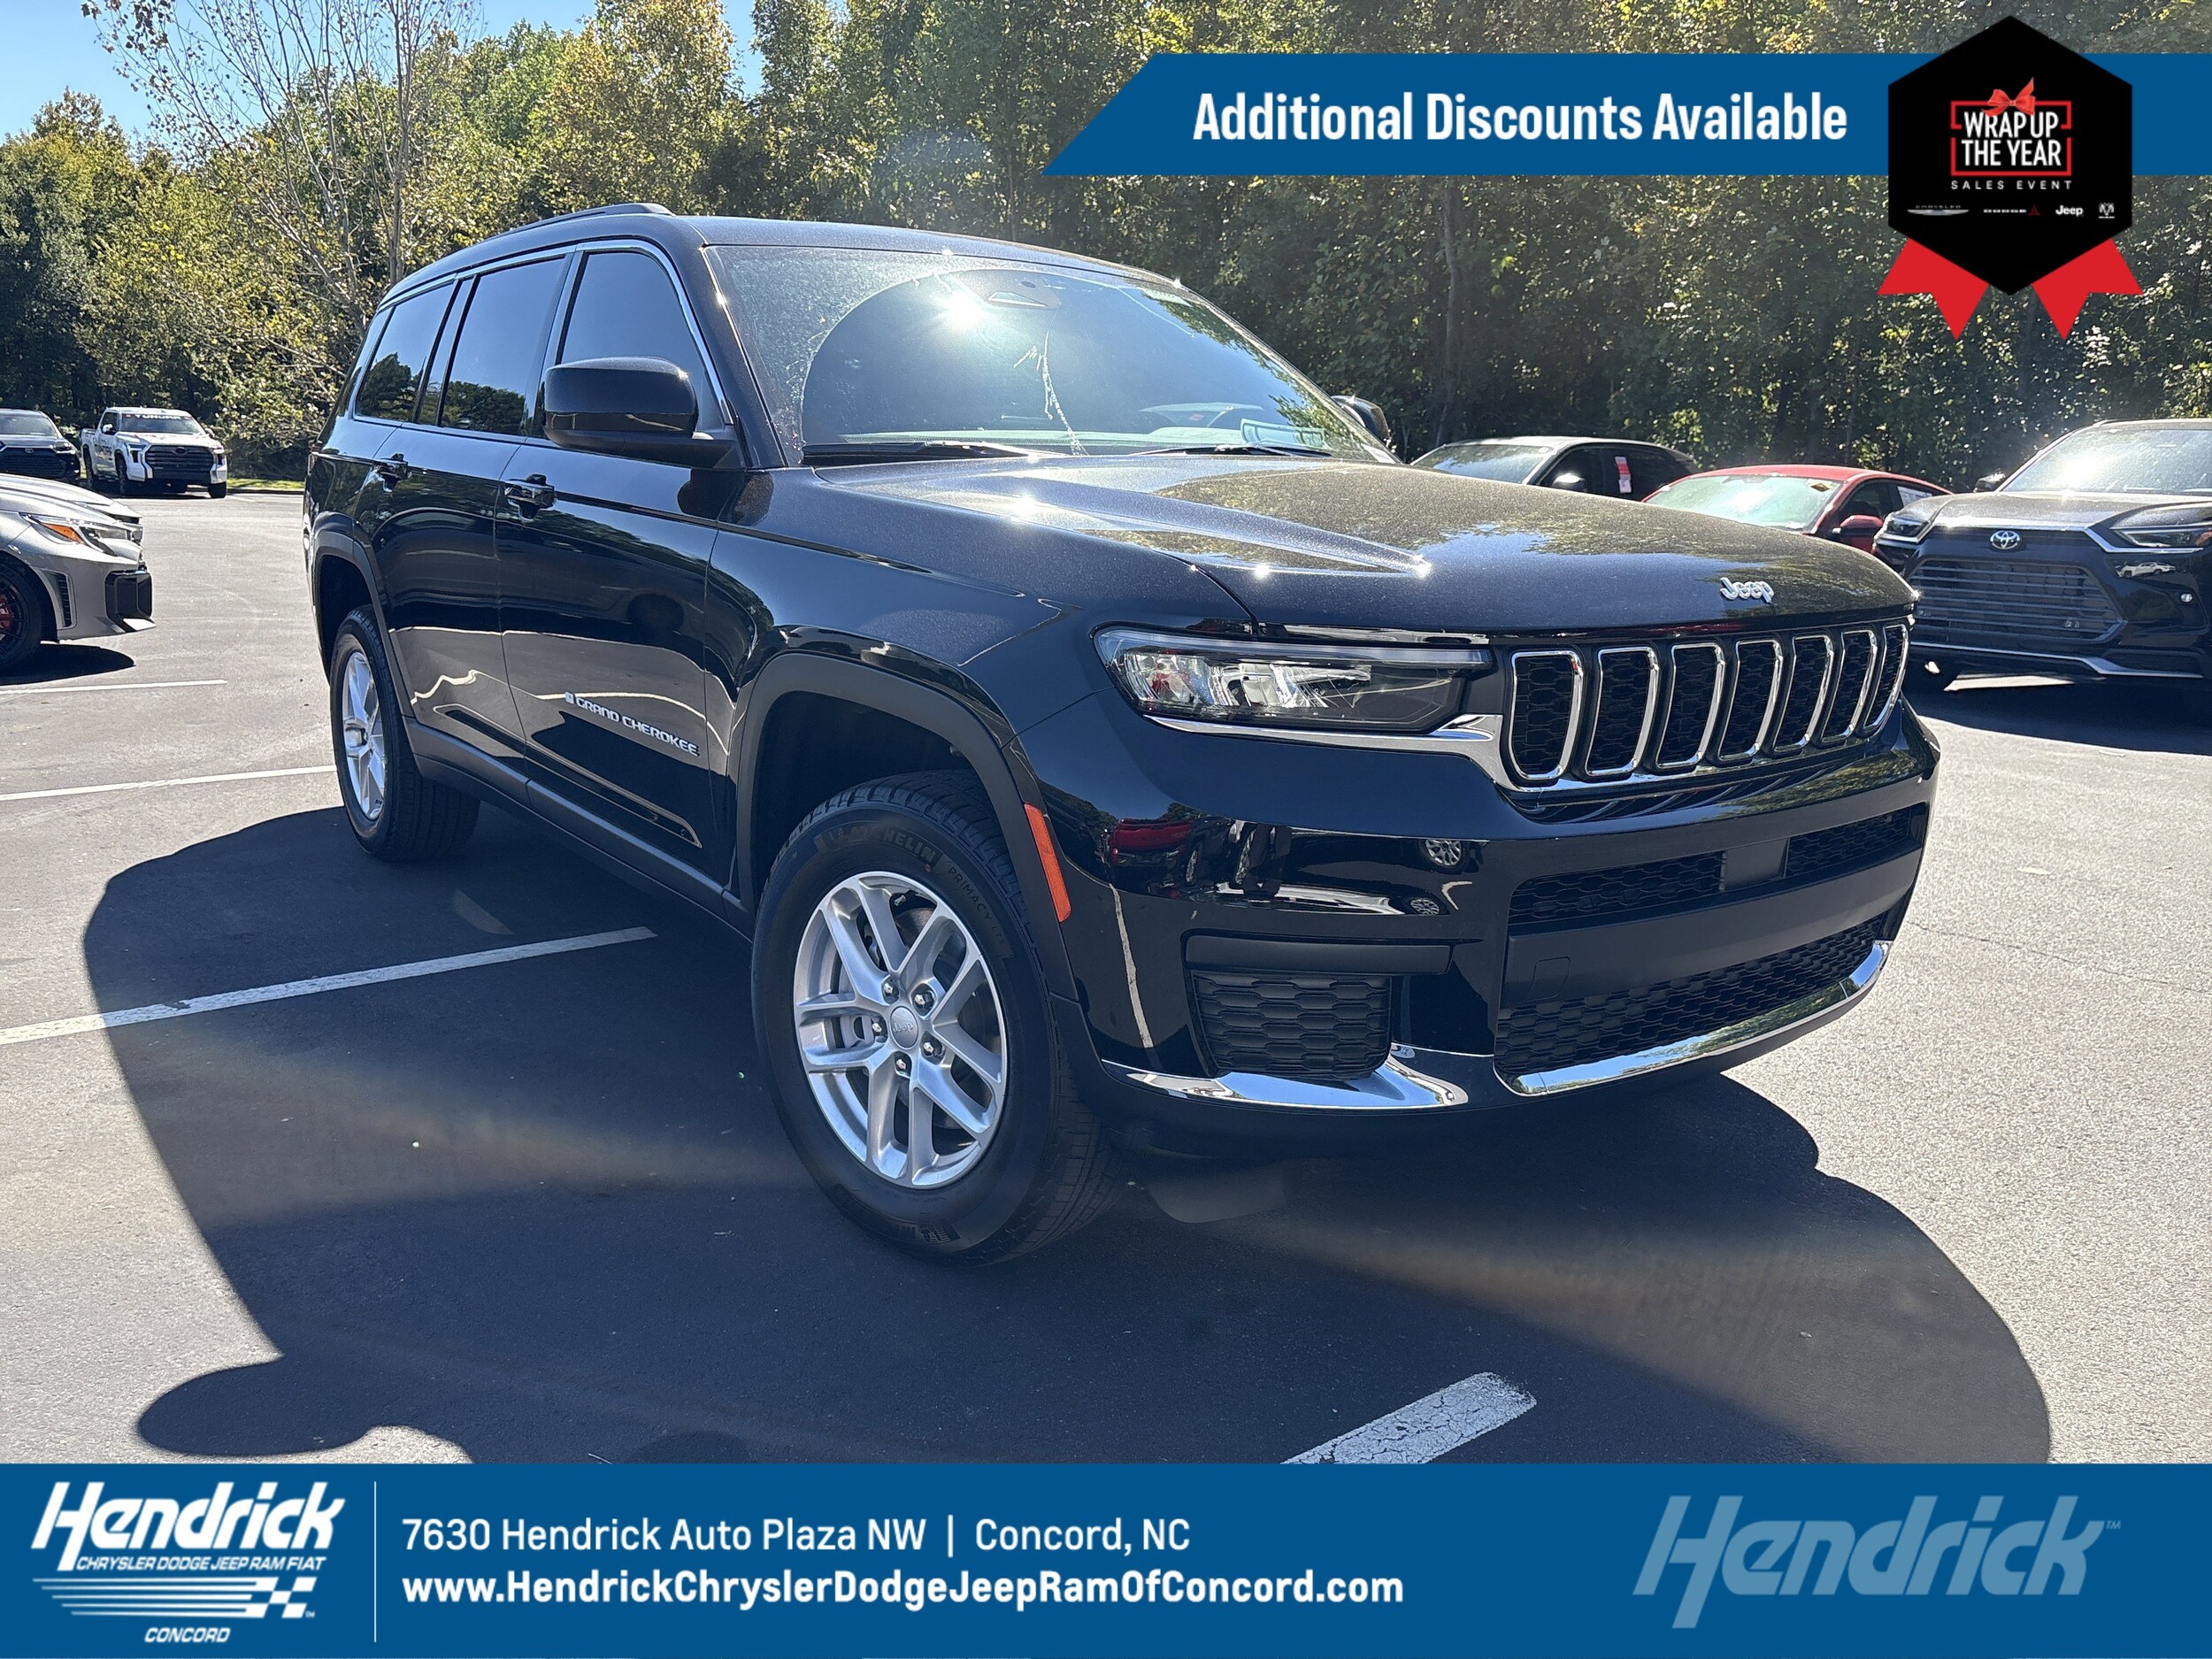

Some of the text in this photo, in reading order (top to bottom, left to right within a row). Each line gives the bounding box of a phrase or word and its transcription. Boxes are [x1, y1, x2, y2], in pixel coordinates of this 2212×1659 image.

[1719, 576, 1775, 603] Jeep
[576, 697, 700, 757] GRAND CHEROKEE
[947, 866, 993, 920] PRIMACY
[892, 1022, 914, 1033] Jeep
